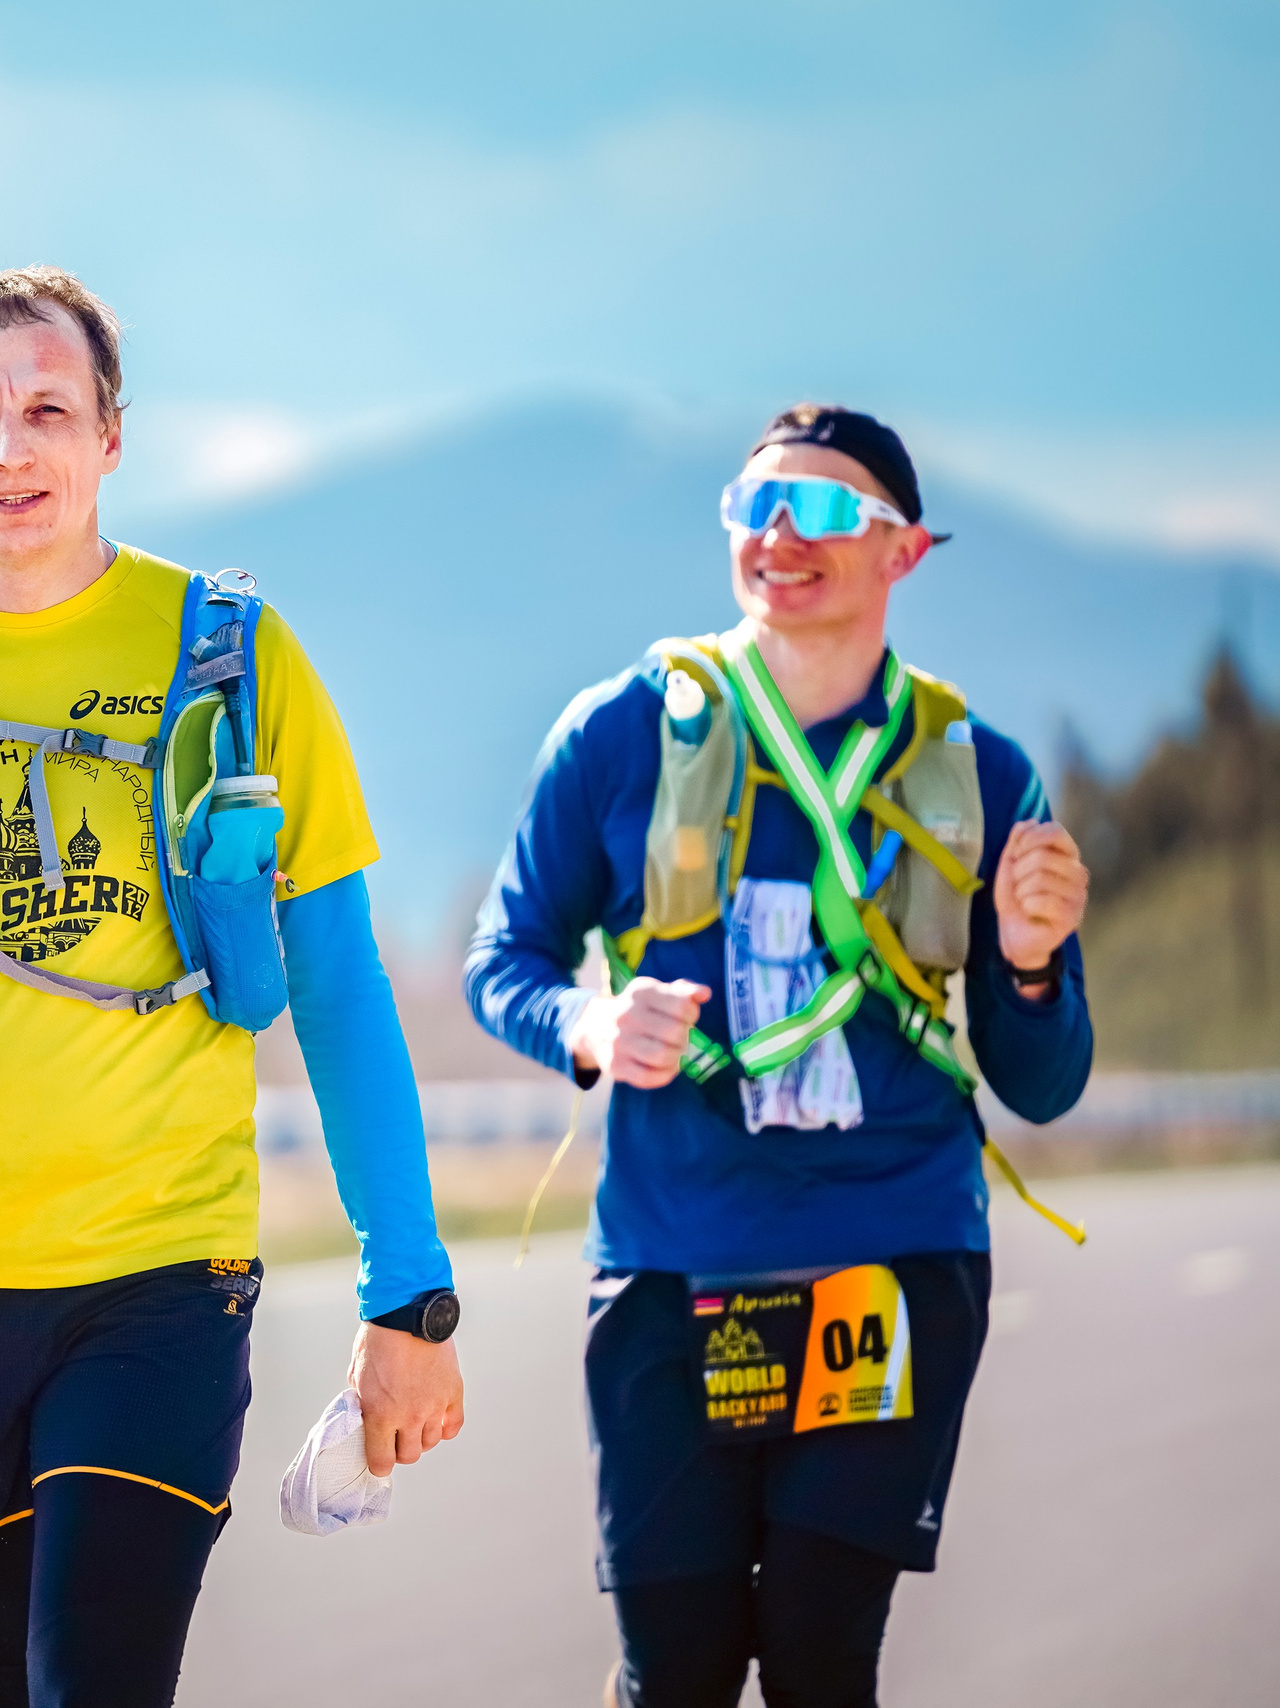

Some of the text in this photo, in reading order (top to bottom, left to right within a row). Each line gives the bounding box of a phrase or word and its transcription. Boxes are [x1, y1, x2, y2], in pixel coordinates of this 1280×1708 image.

[101, 756, 156, 872] НАРОДНЫЙ
[210, 1258, 252, 1275] GOLDEN
[822, 1314, 888, 1373] 04
[704, 1363, 786, 1395] WORLD
